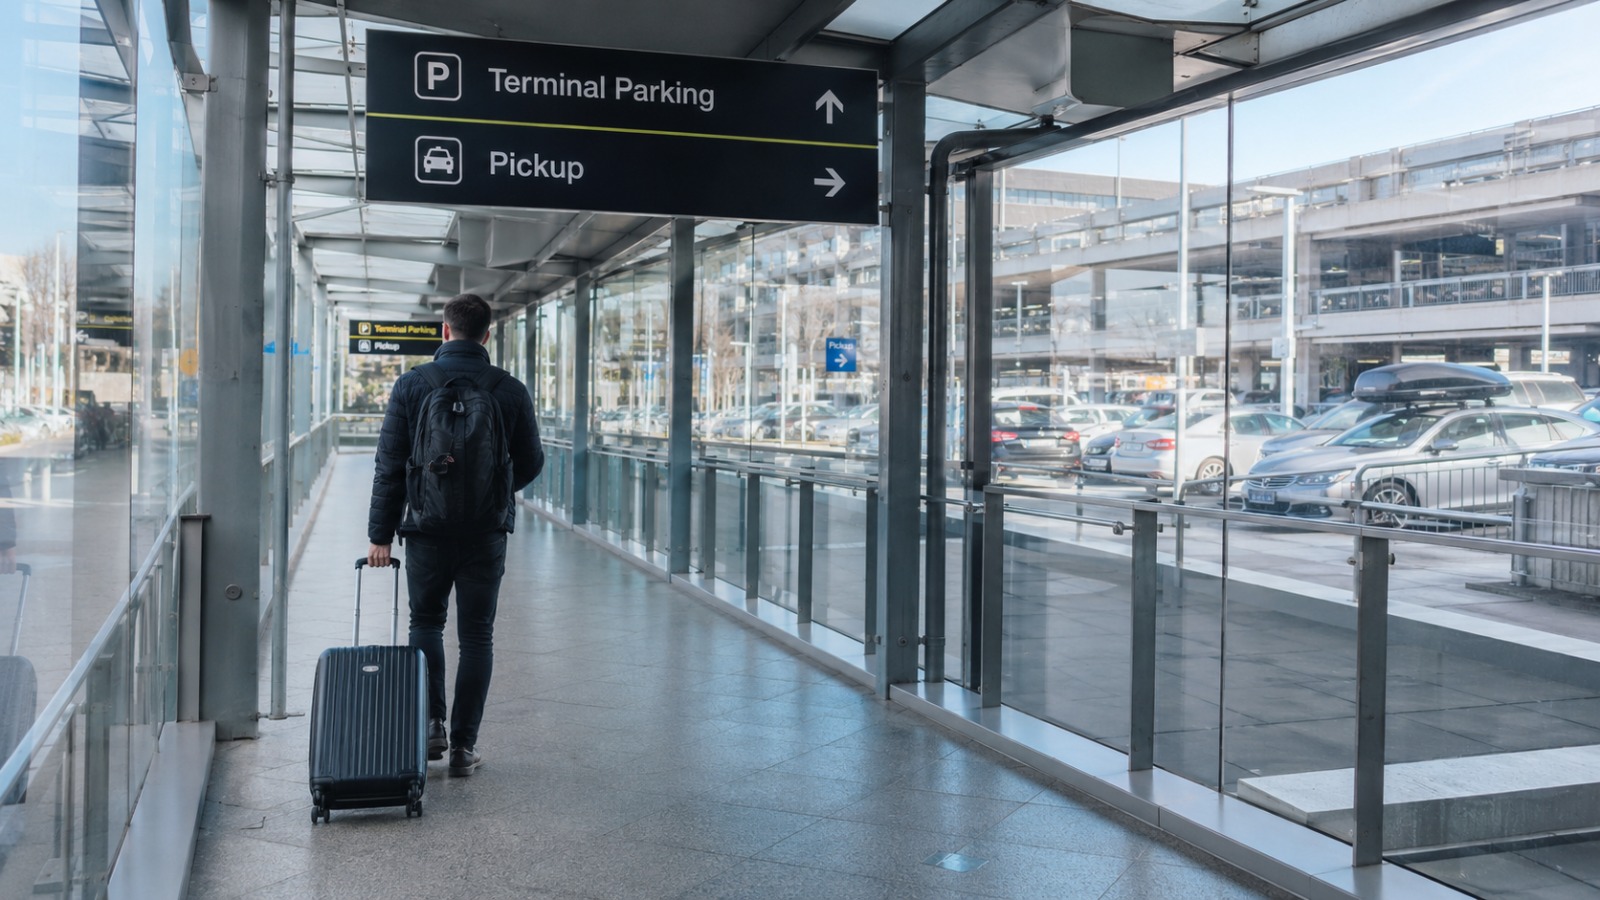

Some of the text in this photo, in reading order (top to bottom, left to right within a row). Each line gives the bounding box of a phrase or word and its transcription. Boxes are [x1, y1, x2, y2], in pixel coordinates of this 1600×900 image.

[427, 61, 450, 90] P
[488, 67, 715, 112] Terminal Parking
[490, 150, 585, 185] Pickup
[374, 324, 437, 336] Terminal Parking
[374, 341, 400, 352] Pickup
